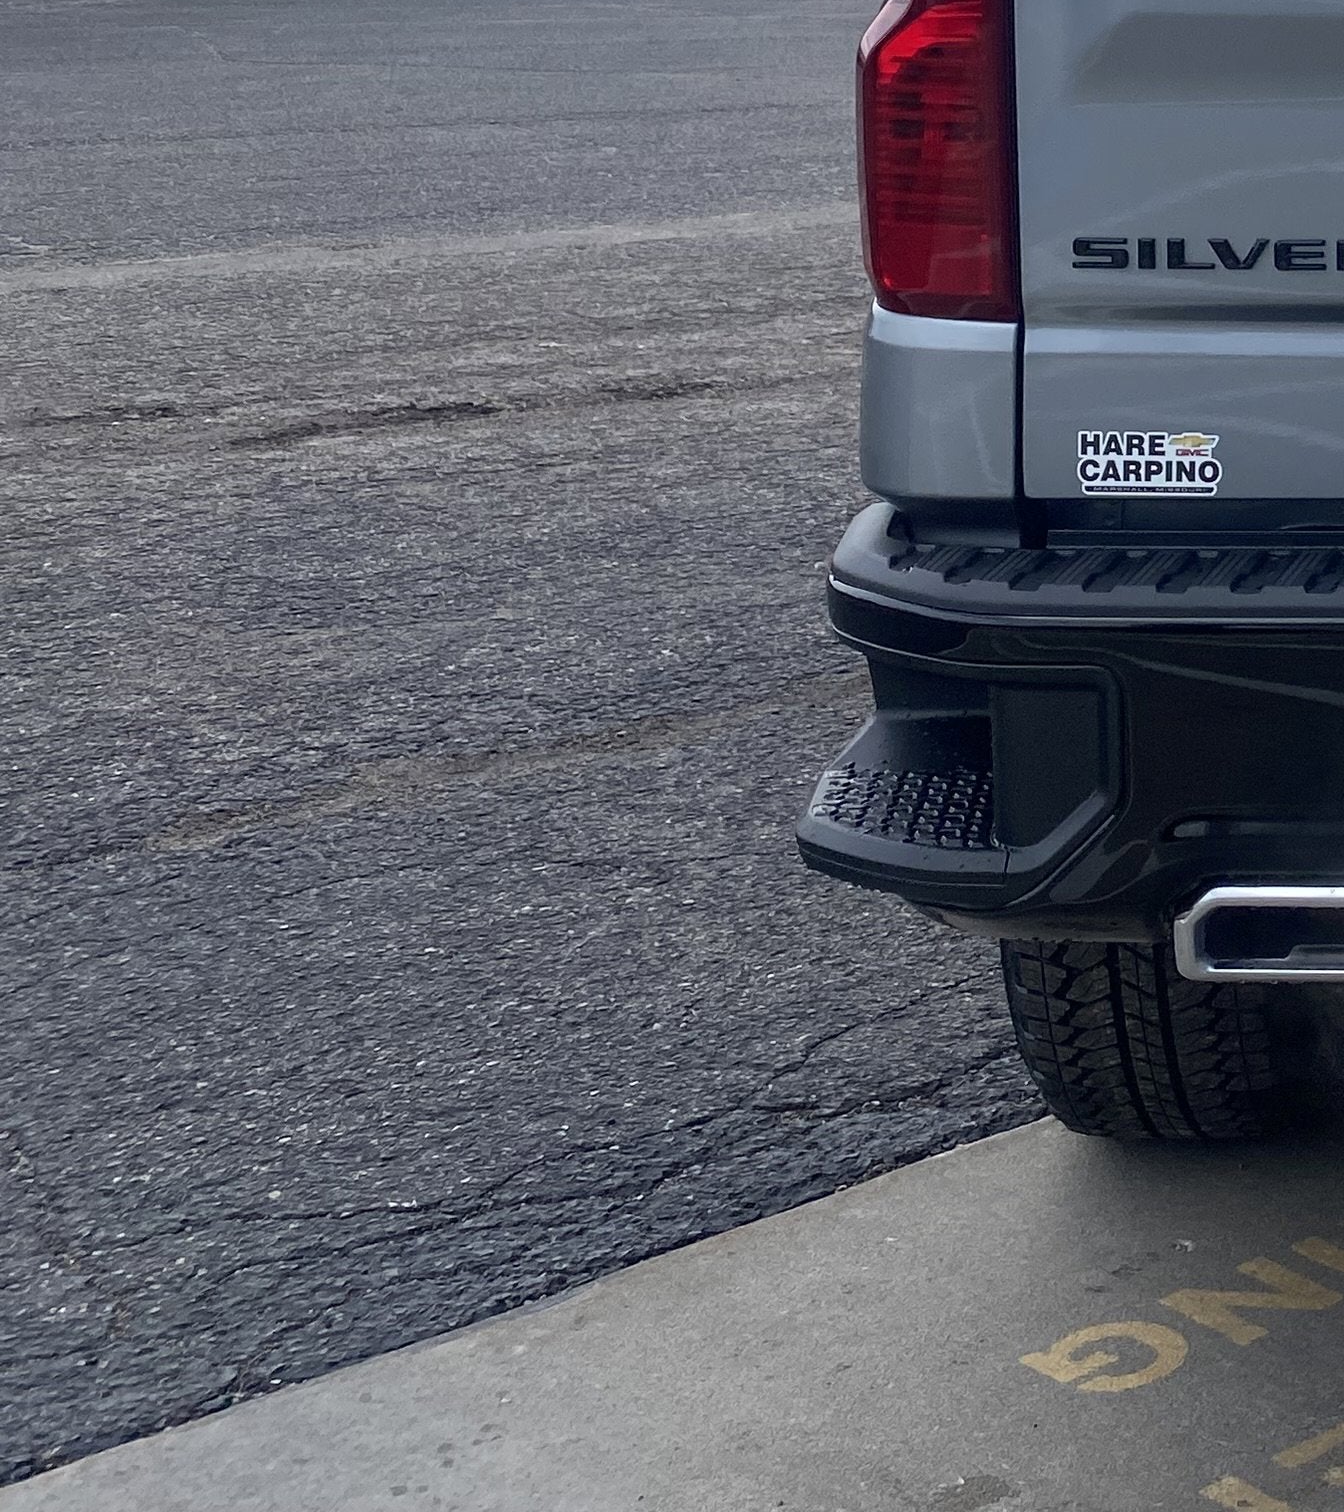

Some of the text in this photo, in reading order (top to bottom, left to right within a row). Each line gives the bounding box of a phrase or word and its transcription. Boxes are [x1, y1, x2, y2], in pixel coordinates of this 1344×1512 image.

[1080, 433, 1166, 457] HARE
[1175, 448, 1210, 457] GMC
[1079, 459, 1220, 483] CARPINO
